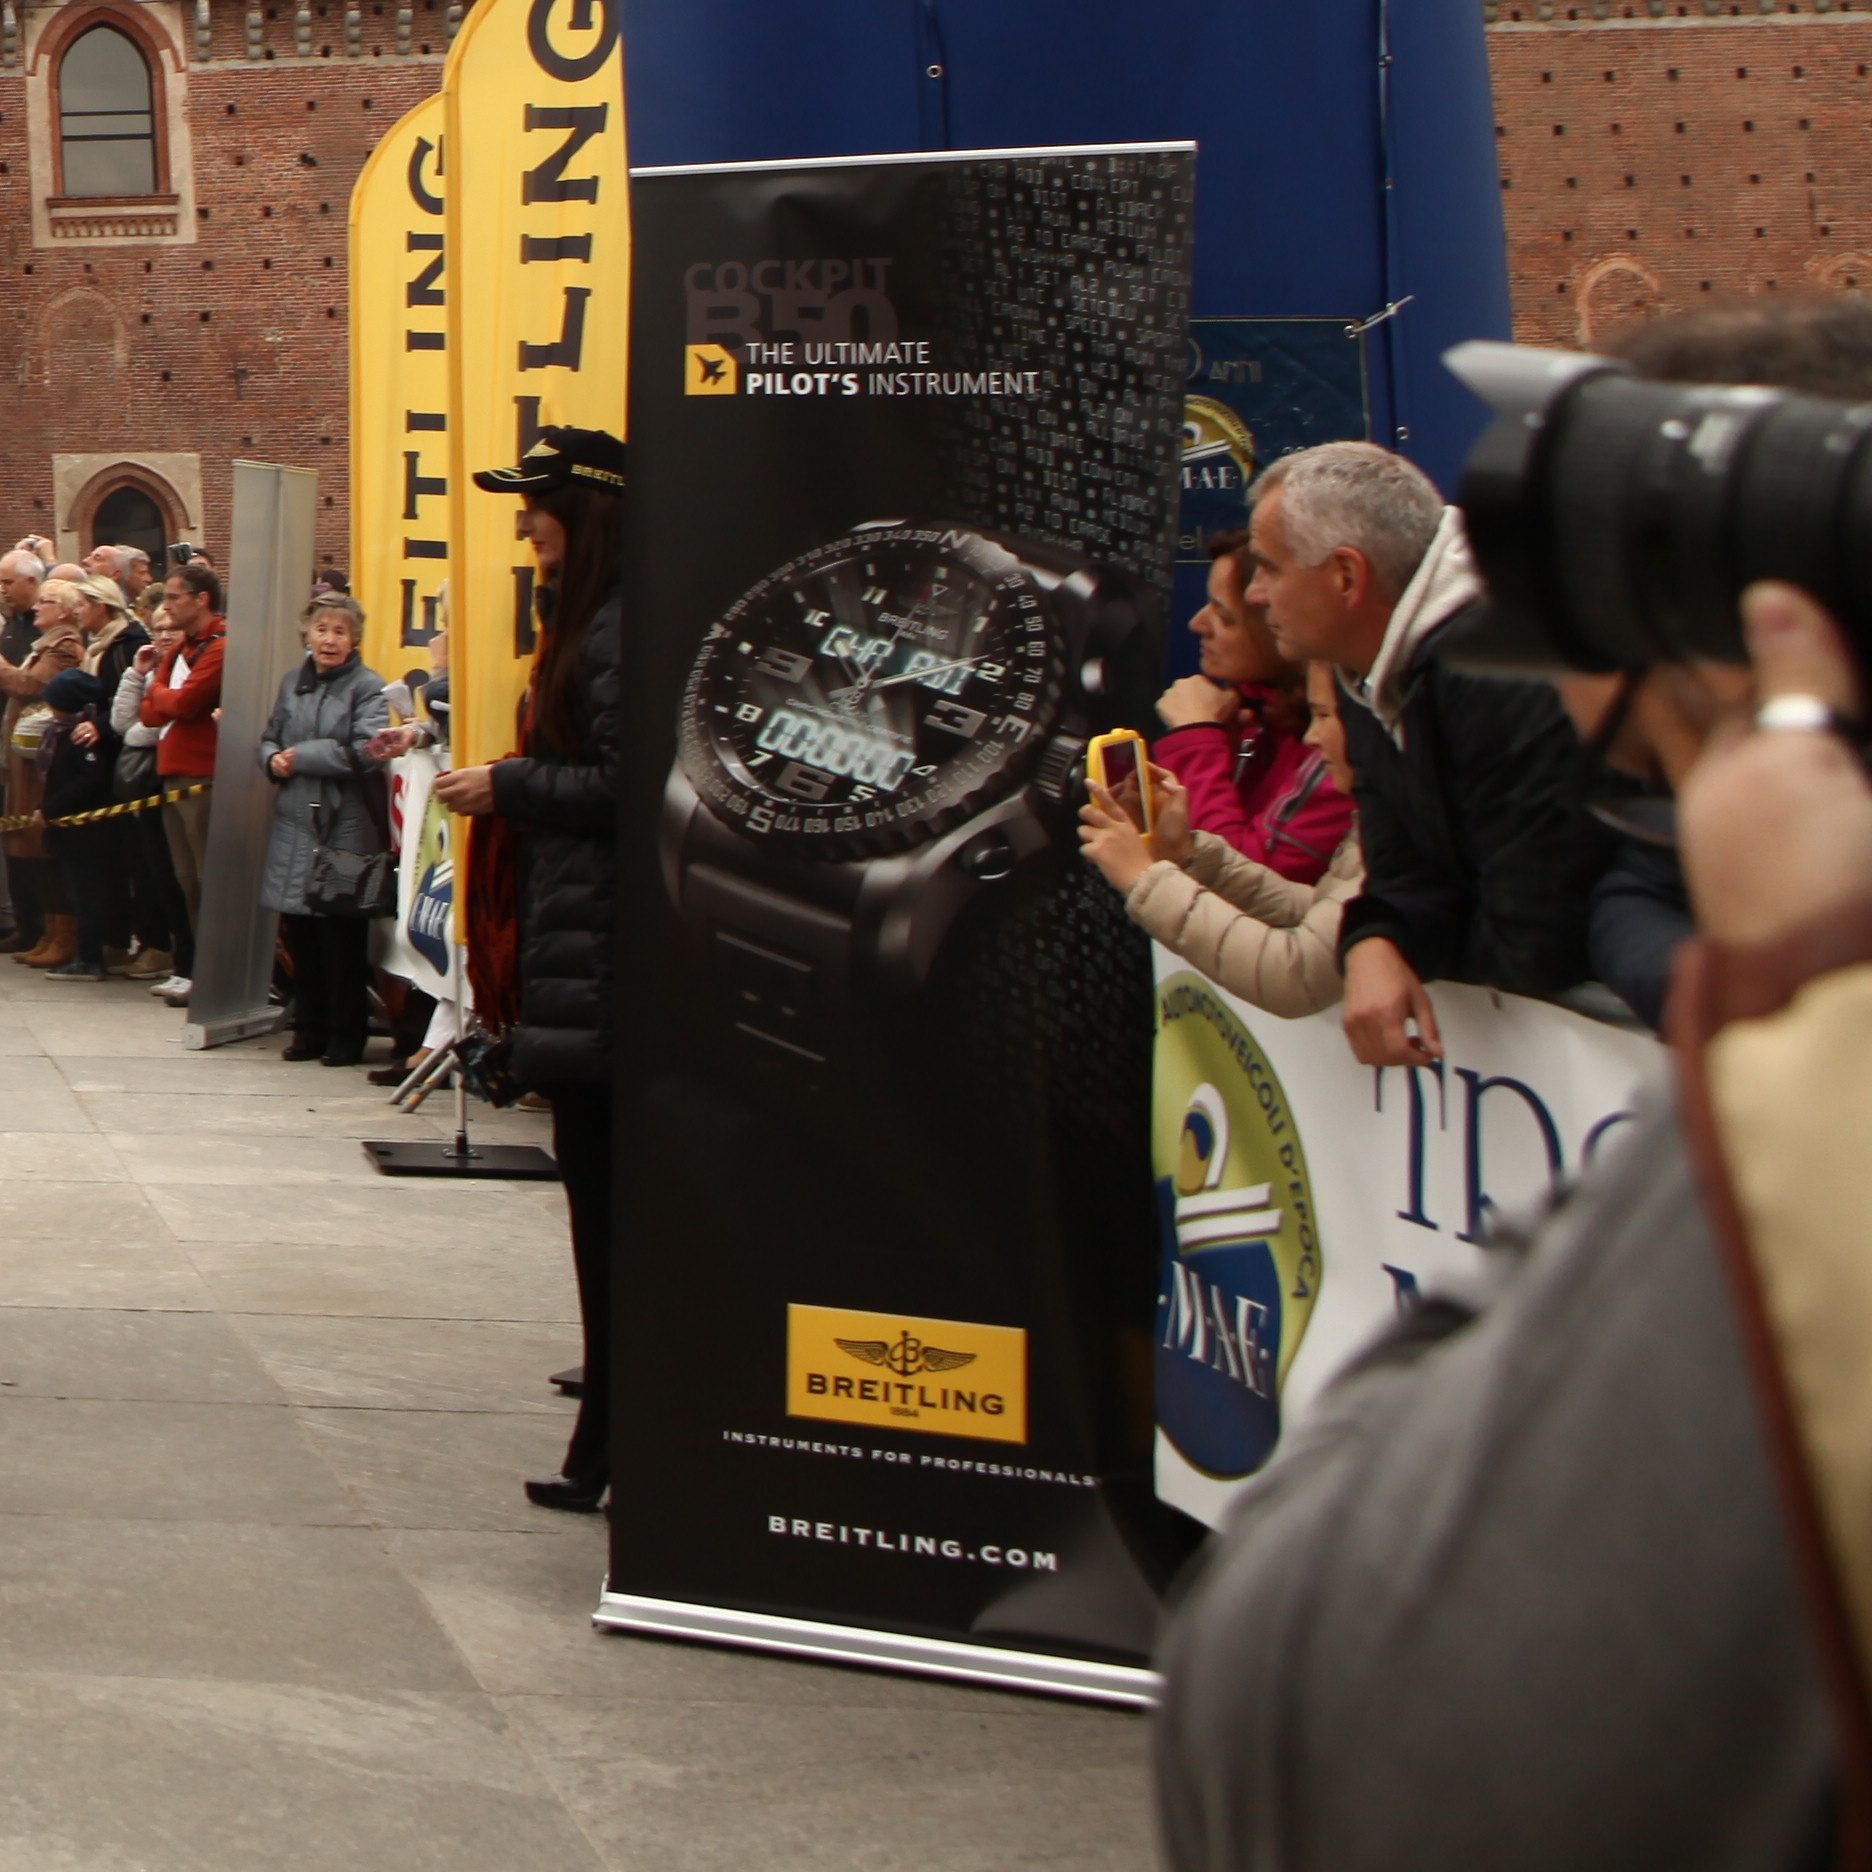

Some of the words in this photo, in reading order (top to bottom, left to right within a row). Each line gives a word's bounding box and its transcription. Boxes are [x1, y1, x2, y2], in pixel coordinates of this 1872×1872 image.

[686, 257, 894, 295] COCKPIT
[686, 287, 899, 364] B50
[746, 342, 795, 364] THE
[803, 340, 930, 364] ULTIMATE
[745, 372, 858, 396] PILOT'S
[868, 370, 1040, 396] INSTRUMENT
[877, 612, 950, 641] BREITLING
[805, 1372, 1006, 1417] BREITLING
[722, 1430, 863, 1459] INSTRUMENTS
[870, 1448, 913, 1464] FOR
[920, 1454, 1096, 1487] PROFESSIONALS
[767, 1514, 1058, 1572] BREITLING.COM
